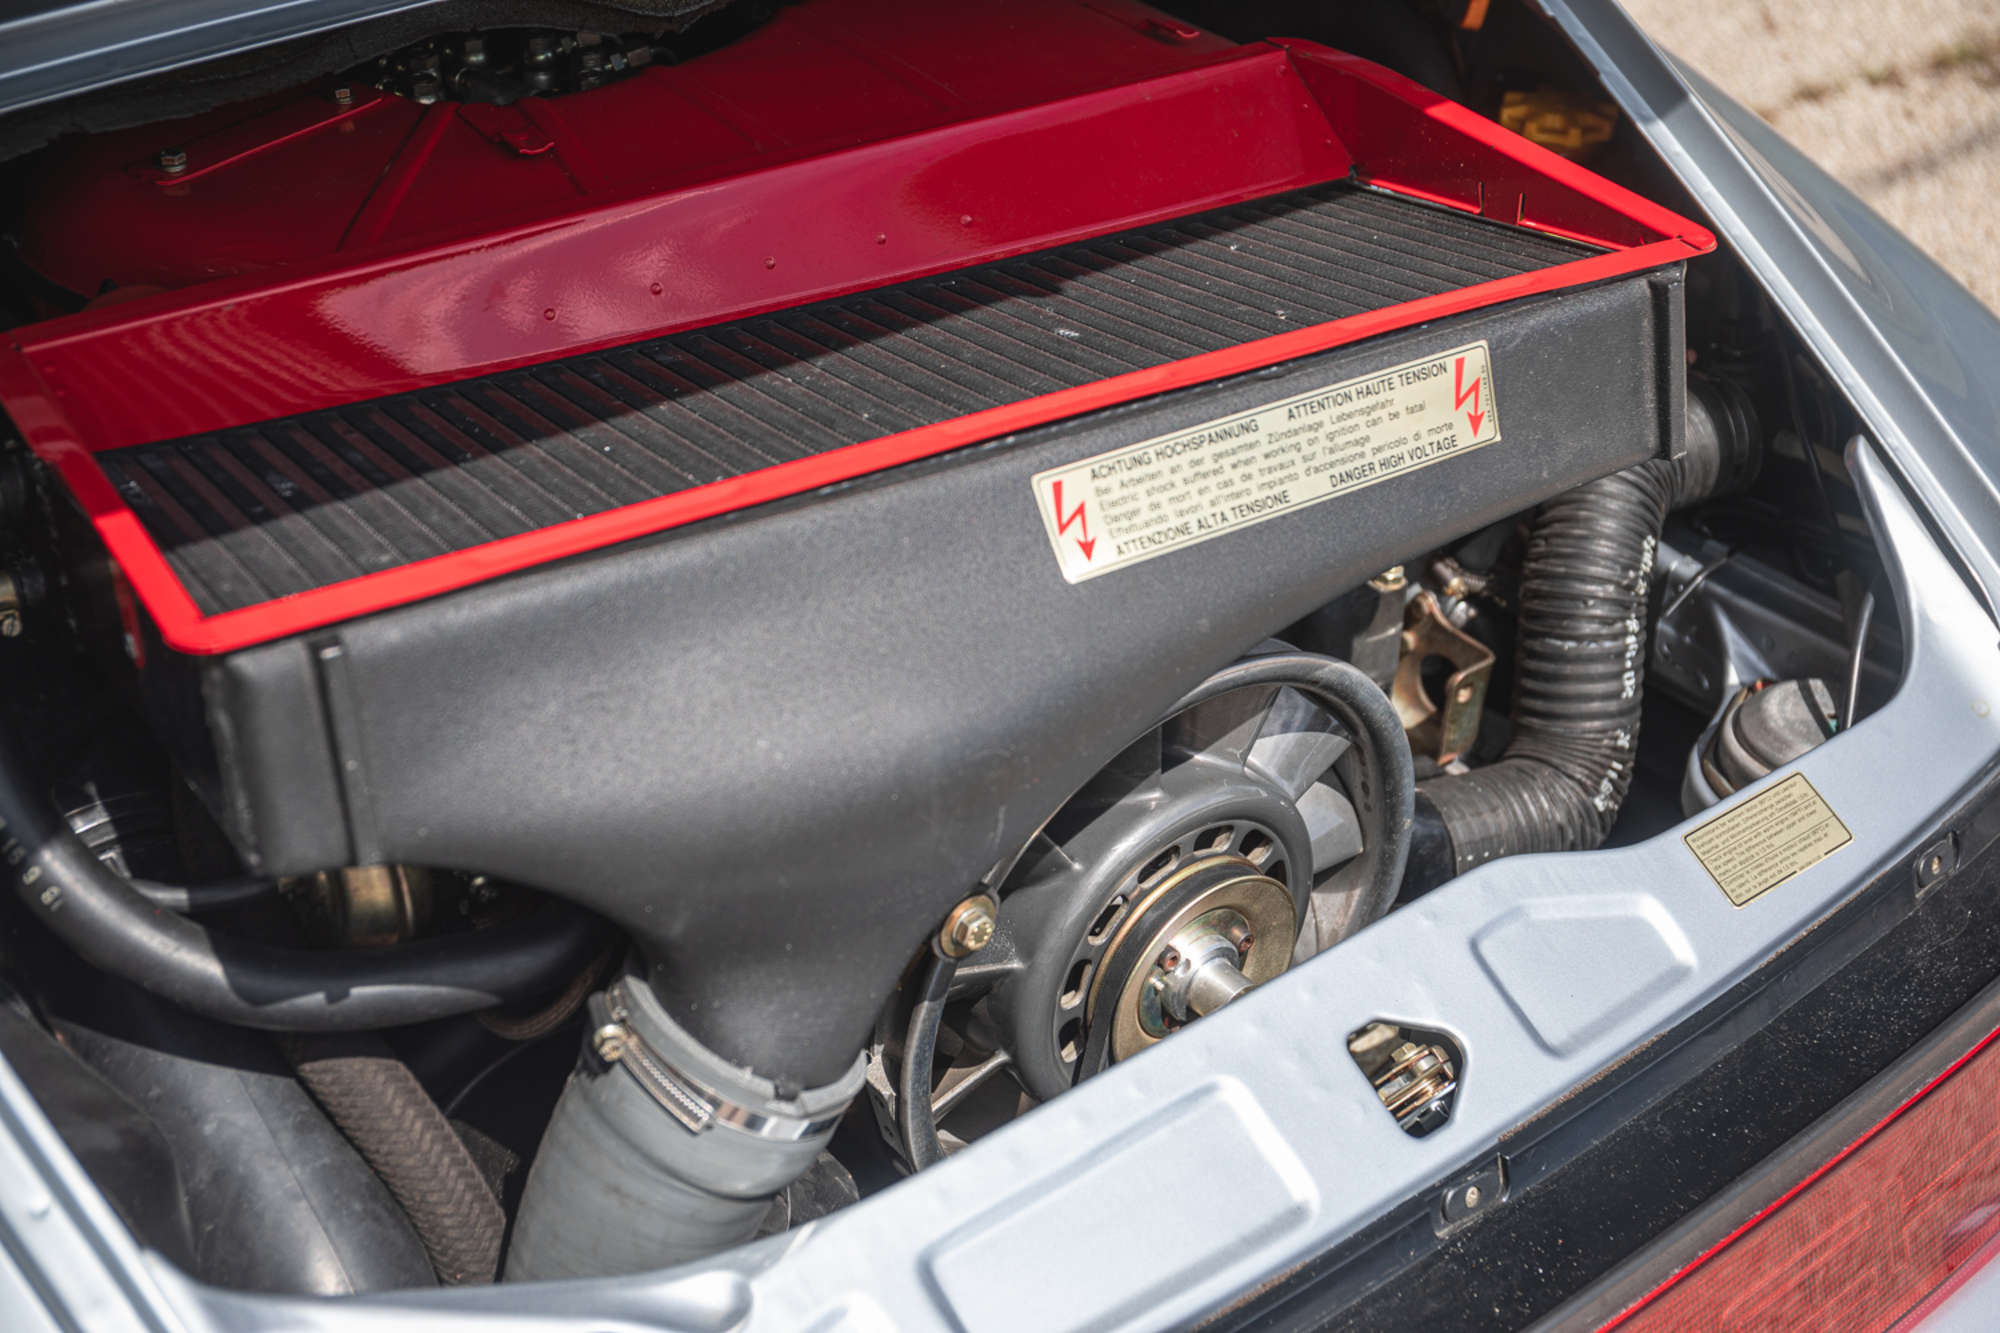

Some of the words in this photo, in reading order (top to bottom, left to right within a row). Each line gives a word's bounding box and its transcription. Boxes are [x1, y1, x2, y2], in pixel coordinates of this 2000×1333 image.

[1285, 388, 1353, 422] ATTENTION
[1355, 375, 1397, 401] HAUTE
[1398, 360, 1448, 388] TENSION
[1088, 450, 1153, 482] ACHTUNG
[1153, 417, 1260, 462] HOCHSPANNUNG
[1144, 478, 1177, 497] shock
[1181, 463, 1225, 486] suffered
[1228, 452, 1258, 471] when
[1261, 438, 1303, 462] working
[1306, 435, 1320, 446] on
[1323, 420, 1361, 443] ignition
[1364, 415, 1384, 428] can
[1387, 408, 1400, 421] be
[1404, 400, 1426, 416] fatal
[1168, 463, 1184, 475] an
[1188, 454, 1207, 469] der
[1210, 437, 1262, 464] gesamten
[1266, 417, 1325, 446] Zündanlage
[1329, 395, 1396, 427] Lebensgefahr
[1328, 459, 1377, 489] DANGER
[1377, 450, 1406, 473] HIGH
[1407, 433, 1458, 463] VOLTAGE
[1370, 434, 1409, 457] pericolo
[1411, 430, 1423, 443] di
[1426, 420, 1454, 438] morte
[1102, 504, 1143, 528] Danger
[1147, 498, 1162, 512] de
[1167, 489, 1192, 506] mort
[1197, 485, 1212, 497] en
[1216, 477, 1235, 491] cas
[1238, 469, 1254, 483] de
[1257, 456, 1296, 477] travaux
[1301, 451, 1317, 464] sur
[1113, 520, 1194, 559] ATTENZIONE
[1194, 509, 1229, 533] ALTA
[1229, 488, 1291, 521] TENSIONE
